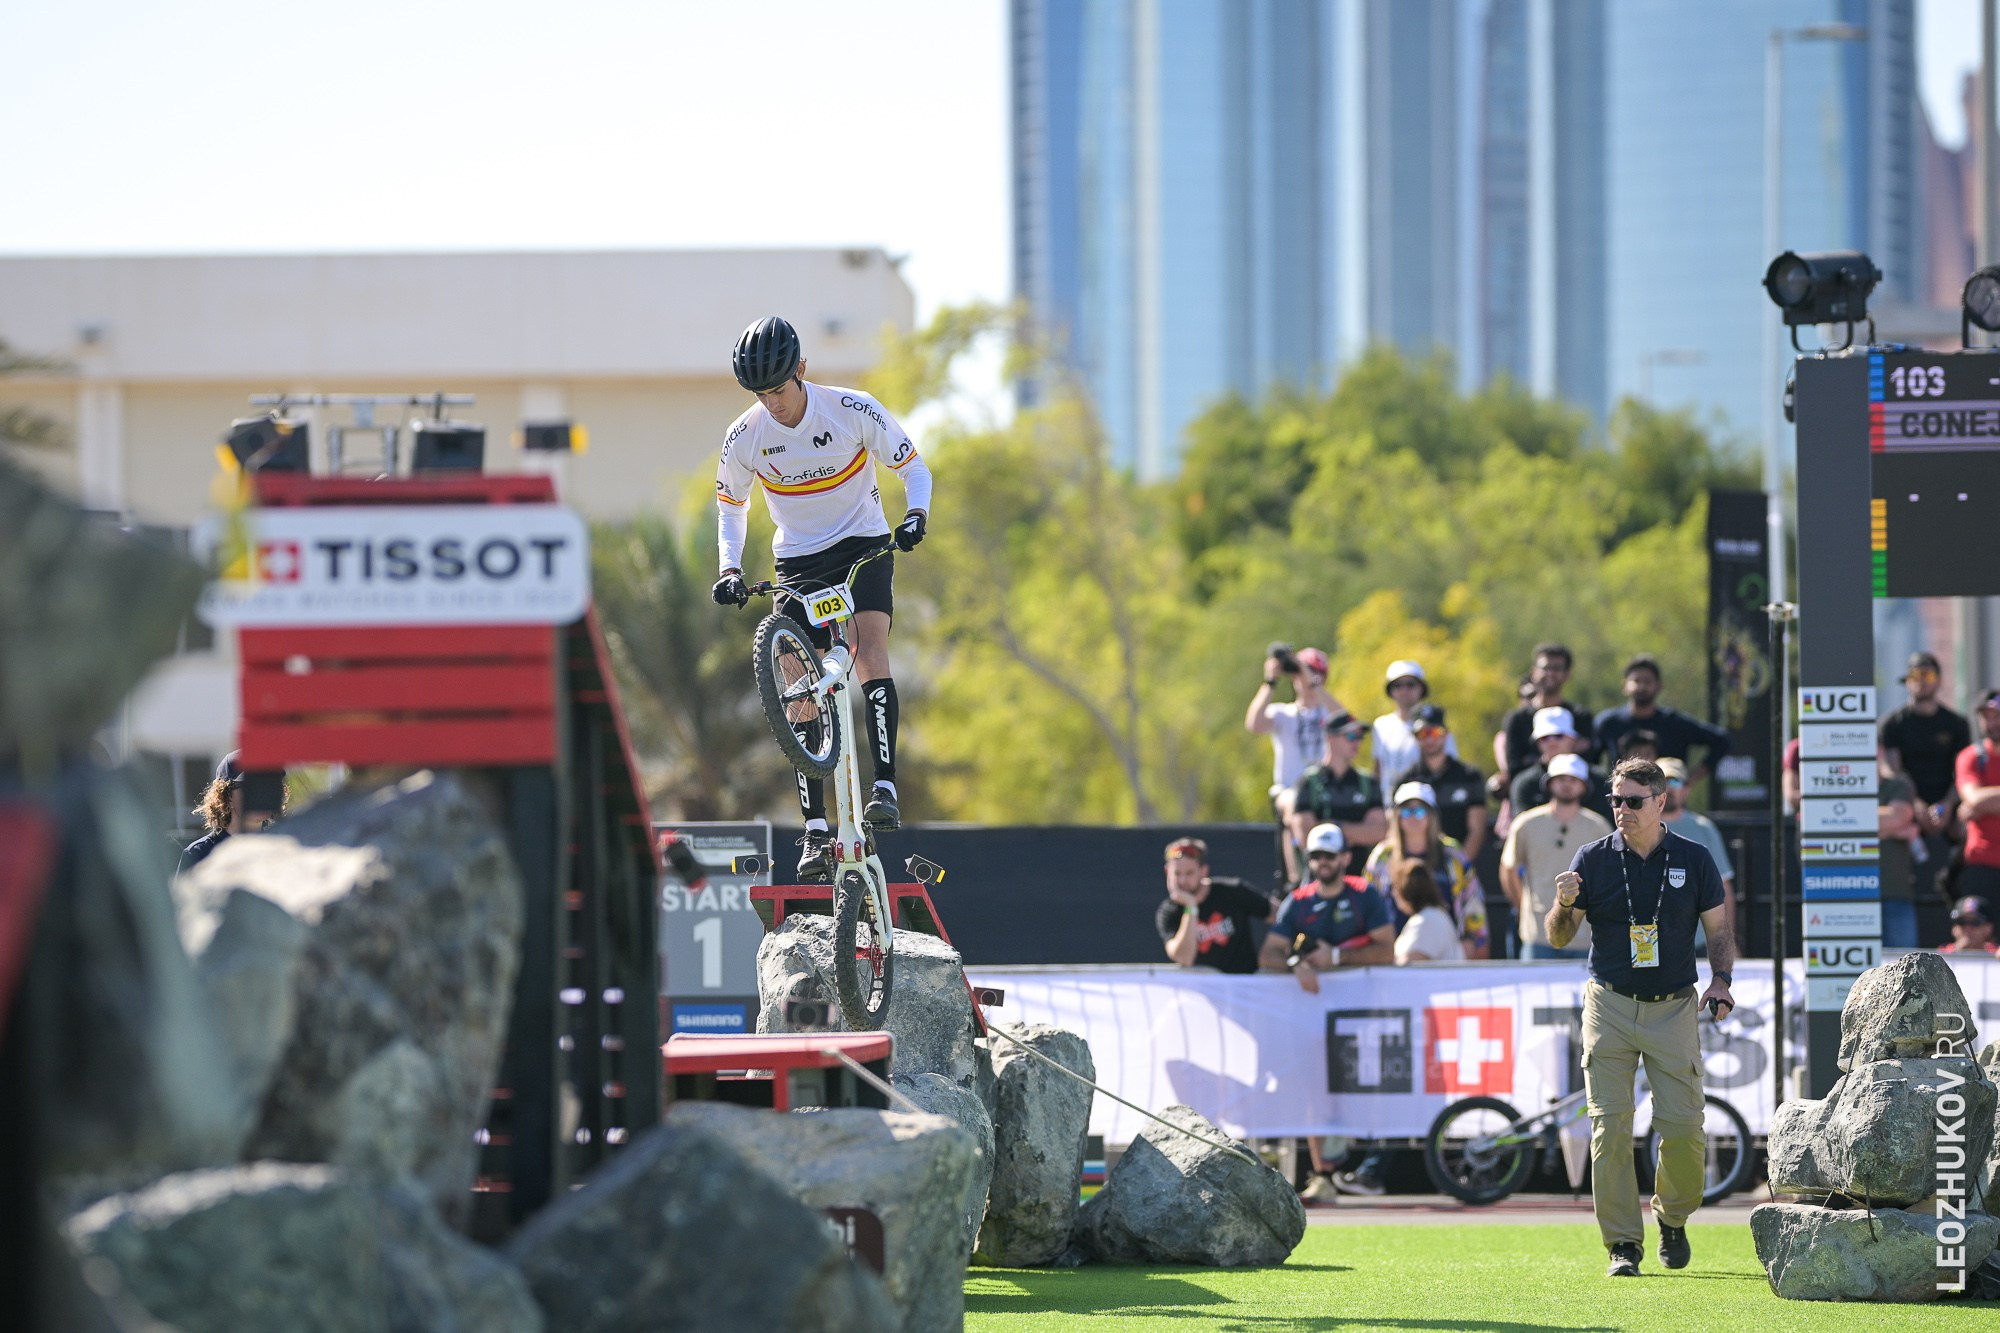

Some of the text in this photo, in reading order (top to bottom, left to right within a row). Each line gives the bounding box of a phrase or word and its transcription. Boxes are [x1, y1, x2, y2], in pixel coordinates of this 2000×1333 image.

[1890, 366, 1947, 398] 103
[841, 396, 887, 431] Cofidis
[315, 537, 568, 581] TISSOT
[816, 597, 842, 617] 103
[1815, 693, 1867, 713] UCI
[1811, 776, 1868, 787] TISSOT
[1825, 842, 1857, 854] UCI
[1805, 875, 1880, 890] SHIMANO
[693, 916, 723, 988] 1
[1820, 946, 1873, 967] UCI
[676, 1014, 743, 1028] SHIMANO
